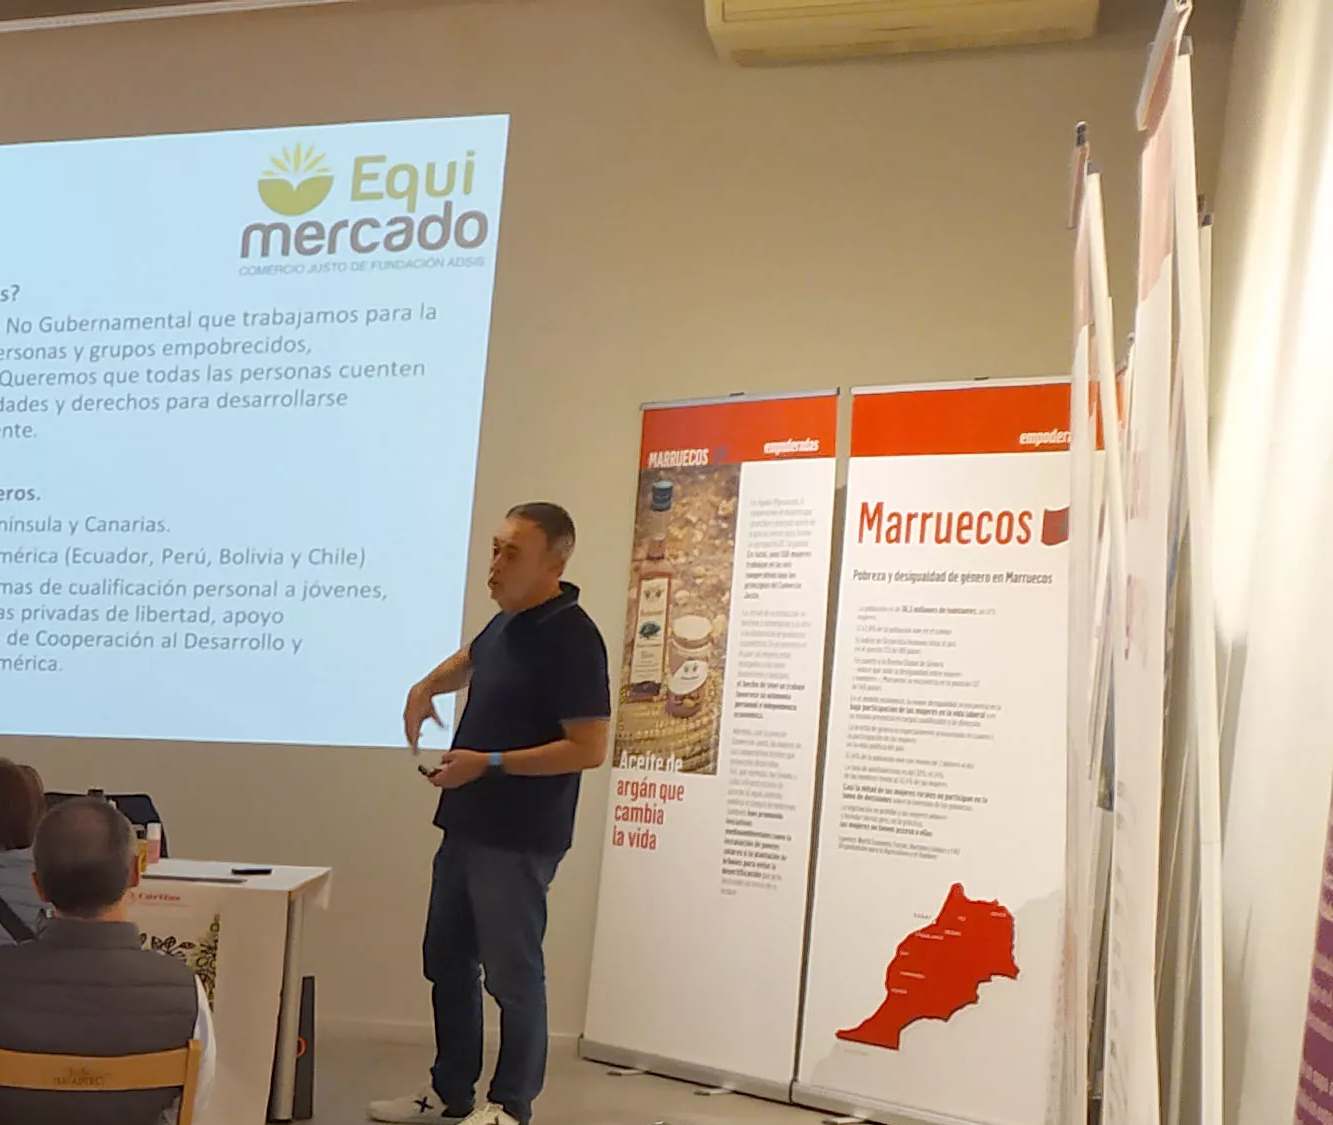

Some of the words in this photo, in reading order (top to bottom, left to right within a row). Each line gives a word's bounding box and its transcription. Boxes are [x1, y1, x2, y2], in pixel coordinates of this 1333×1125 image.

[350, 150, 476, 213] Equi
[240, 200, 489, 258] mercado
[5, 316, 33, 336] No
[38, 309, 192, 335] Gubernamental
[197, 312, 237, 333] que
[242, 306, 359, 331] trabajamos
[365, 306, 413, 327] para
[419, 301, 437, 321] la
[102, 369, 140, 388] que
[145, 363, 201, 384] todas
[206, 363, 234, 383] las
[239, 363, 332, 385] personas
[338, 360, 425, 380] cuenten
[648, 448, 709, 468] MARRUECOS
[68, 520, 79, 537] y
[84, 515, 171, 533] Canarias.
[858, 501, 1033, 545] Marruecos
[64, 545, 154, 569] (Ecuador,
[161, 546, 212, 569] Perú,
[219, 546, 284, 567] Bolivia
[290, 552, 302, 571] y
[308, 546, 366, 570] Chile)
[39, 576, 63, 597] de
[68, 576, 187, 598] cualificación
[192, 578, 278, 601] personal
[284, 584, 296, 599] a
[300, 580, 387, 603] jóvenes,
[6, 628, 30, 647] de
[35, 629, 155, 651] Cooperación
[160, 631, 178, 650] al
[184, 632, 285, 652] Desarrollo
[291, 637, 303, 656] y
[619, 749, 664, 772] Aceite
[666, 752, 684, 773] de
[617, 776, 657, 802] argán
[660, 783, 685, 804] que
[614, 802, 665, 825] cambia
[612, 825, 624, 846] la
[629, 828, 657, 850] vida
